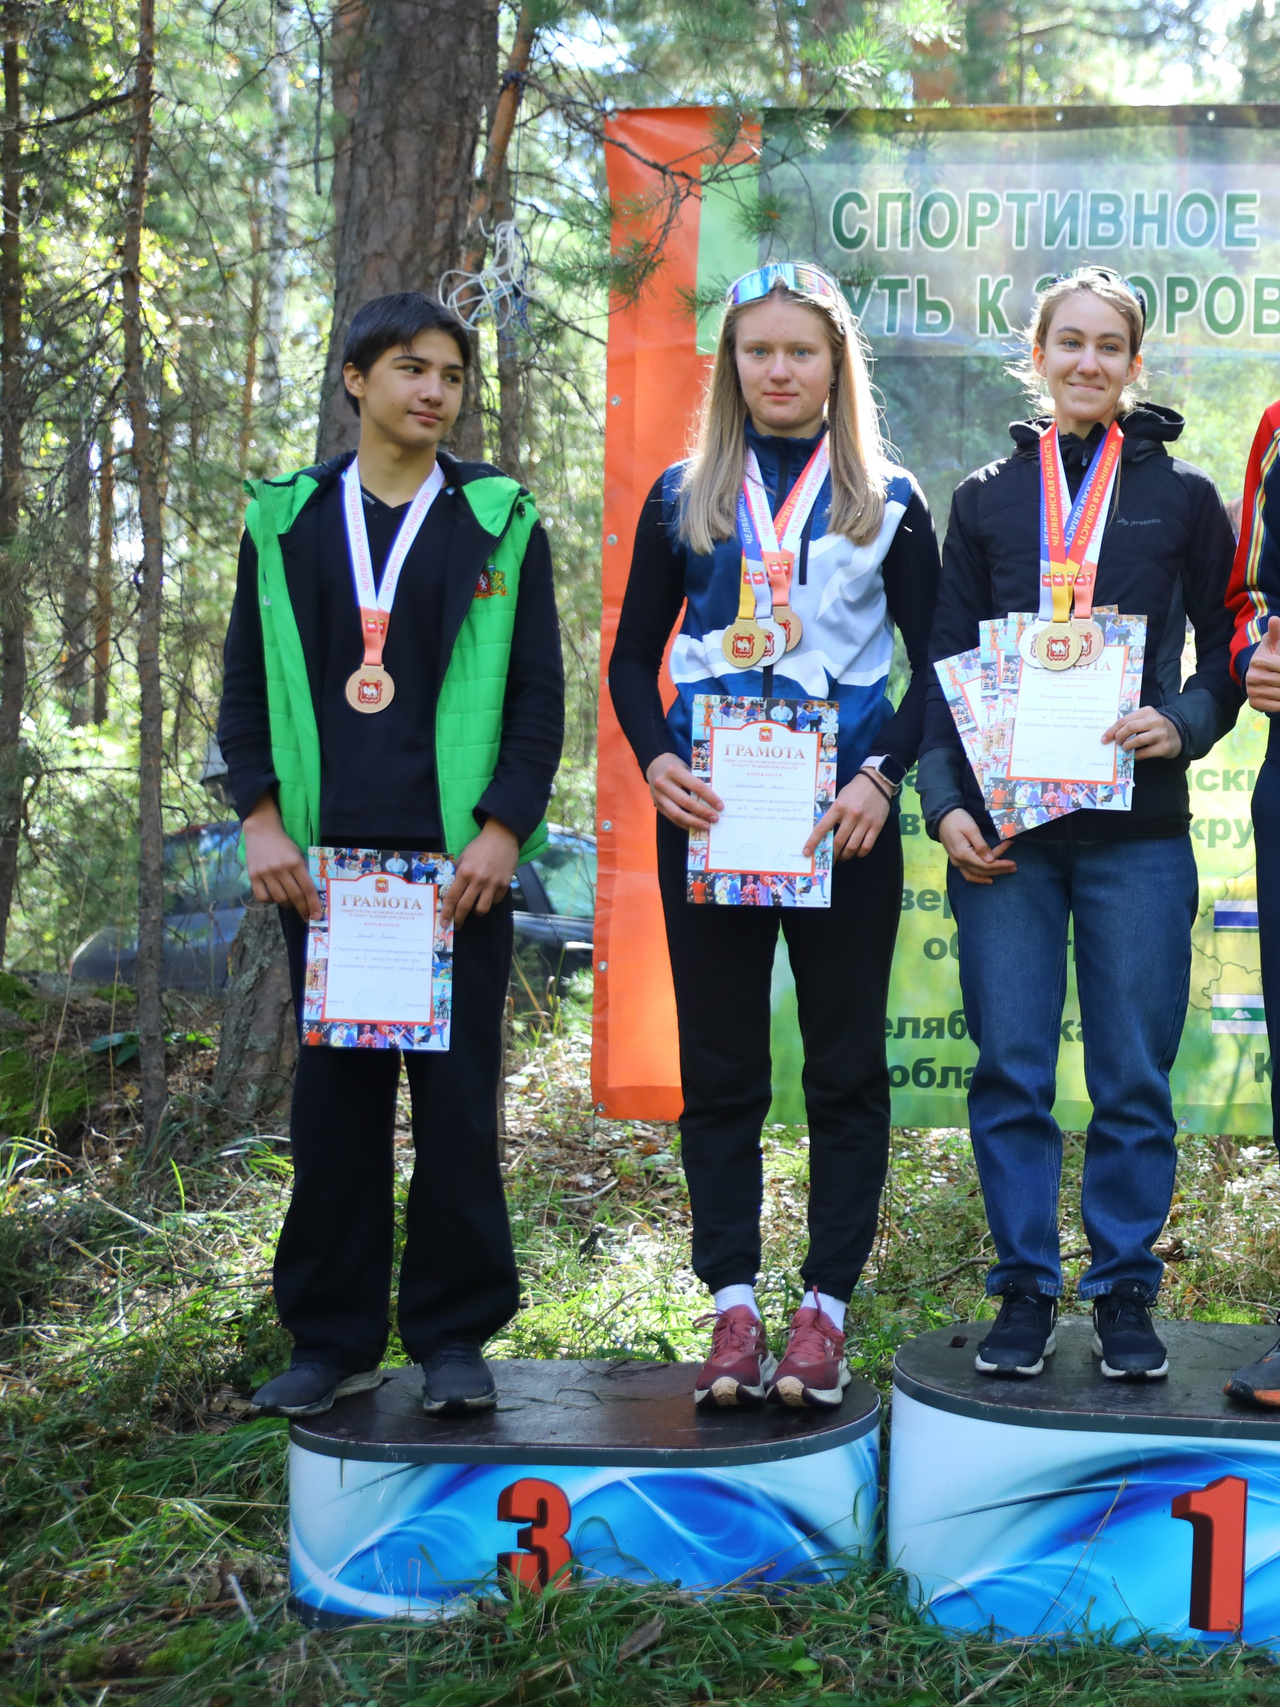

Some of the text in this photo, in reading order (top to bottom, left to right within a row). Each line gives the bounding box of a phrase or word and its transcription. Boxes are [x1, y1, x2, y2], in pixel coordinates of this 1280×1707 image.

[831, 189, 1260, 252] СПОРТИВНОЕ
[838, 273, 955, 337] УТЬ
[977, 275, 1012, 338] К
[1044, 439, 1060, 546] ЧЕЛЯБИНСКАЯ ОБЛАСТЬ
[1078, 441, 1118, 546] ЧЕЛЯБИНСКАЯ ОБЛАСТЬ
[724, 744, 806, 759] ГРАМОТА
[341, 894, 423, 910] ГРАМОТА
[496, 1477, 573, 1593] 3
[1171, 1474, 1250, 1633] 1
